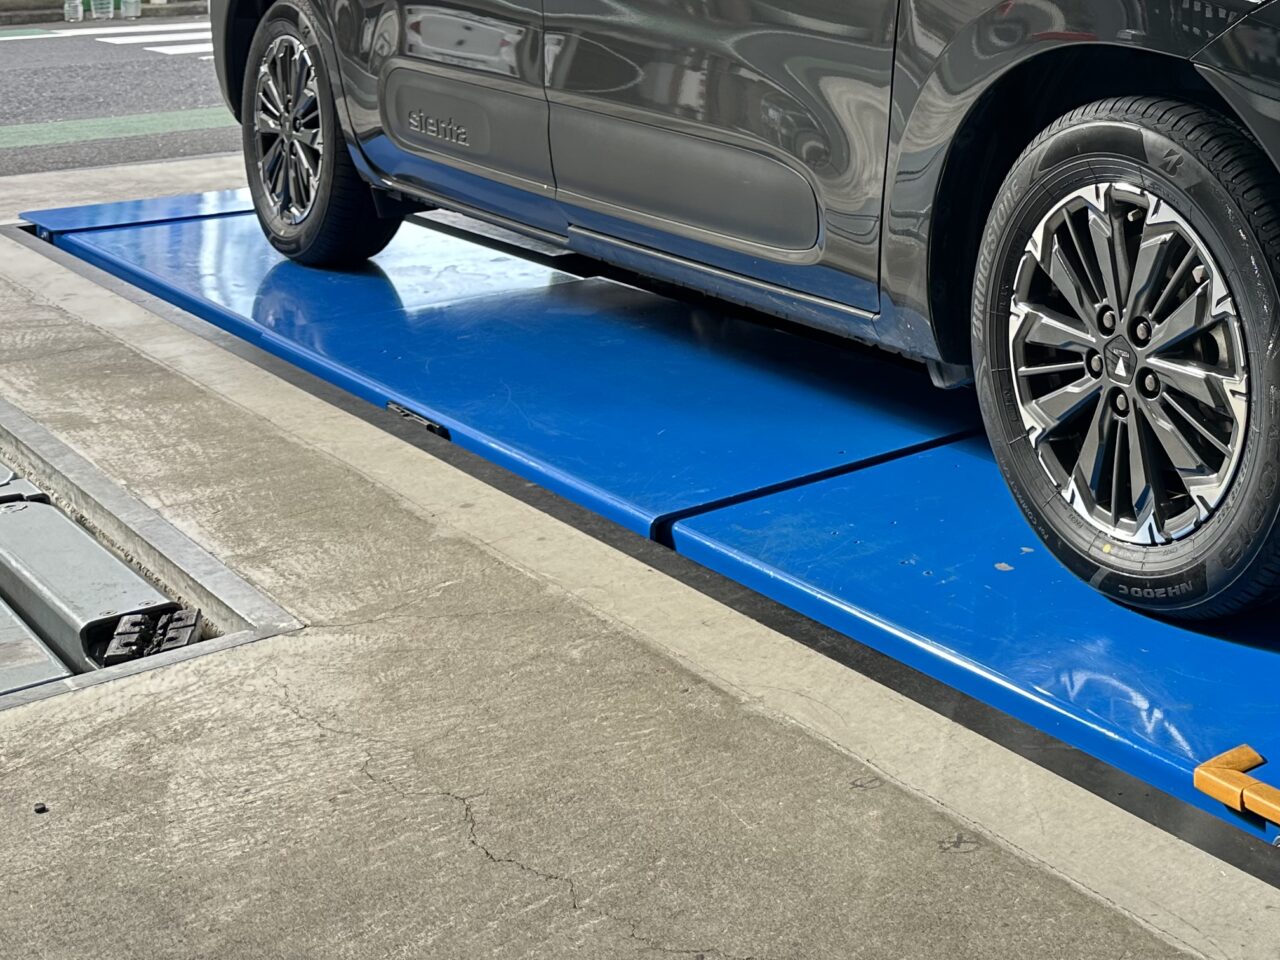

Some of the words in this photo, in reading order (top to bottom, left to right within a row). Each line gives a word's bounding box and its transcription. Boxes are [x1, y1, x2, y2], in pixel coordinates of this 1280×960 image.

[408, 109, 469, 147] sienta
[972, 179, 1021, 341] BRIDGESTONE
[1118, 580, 1193, 598] NH200C
